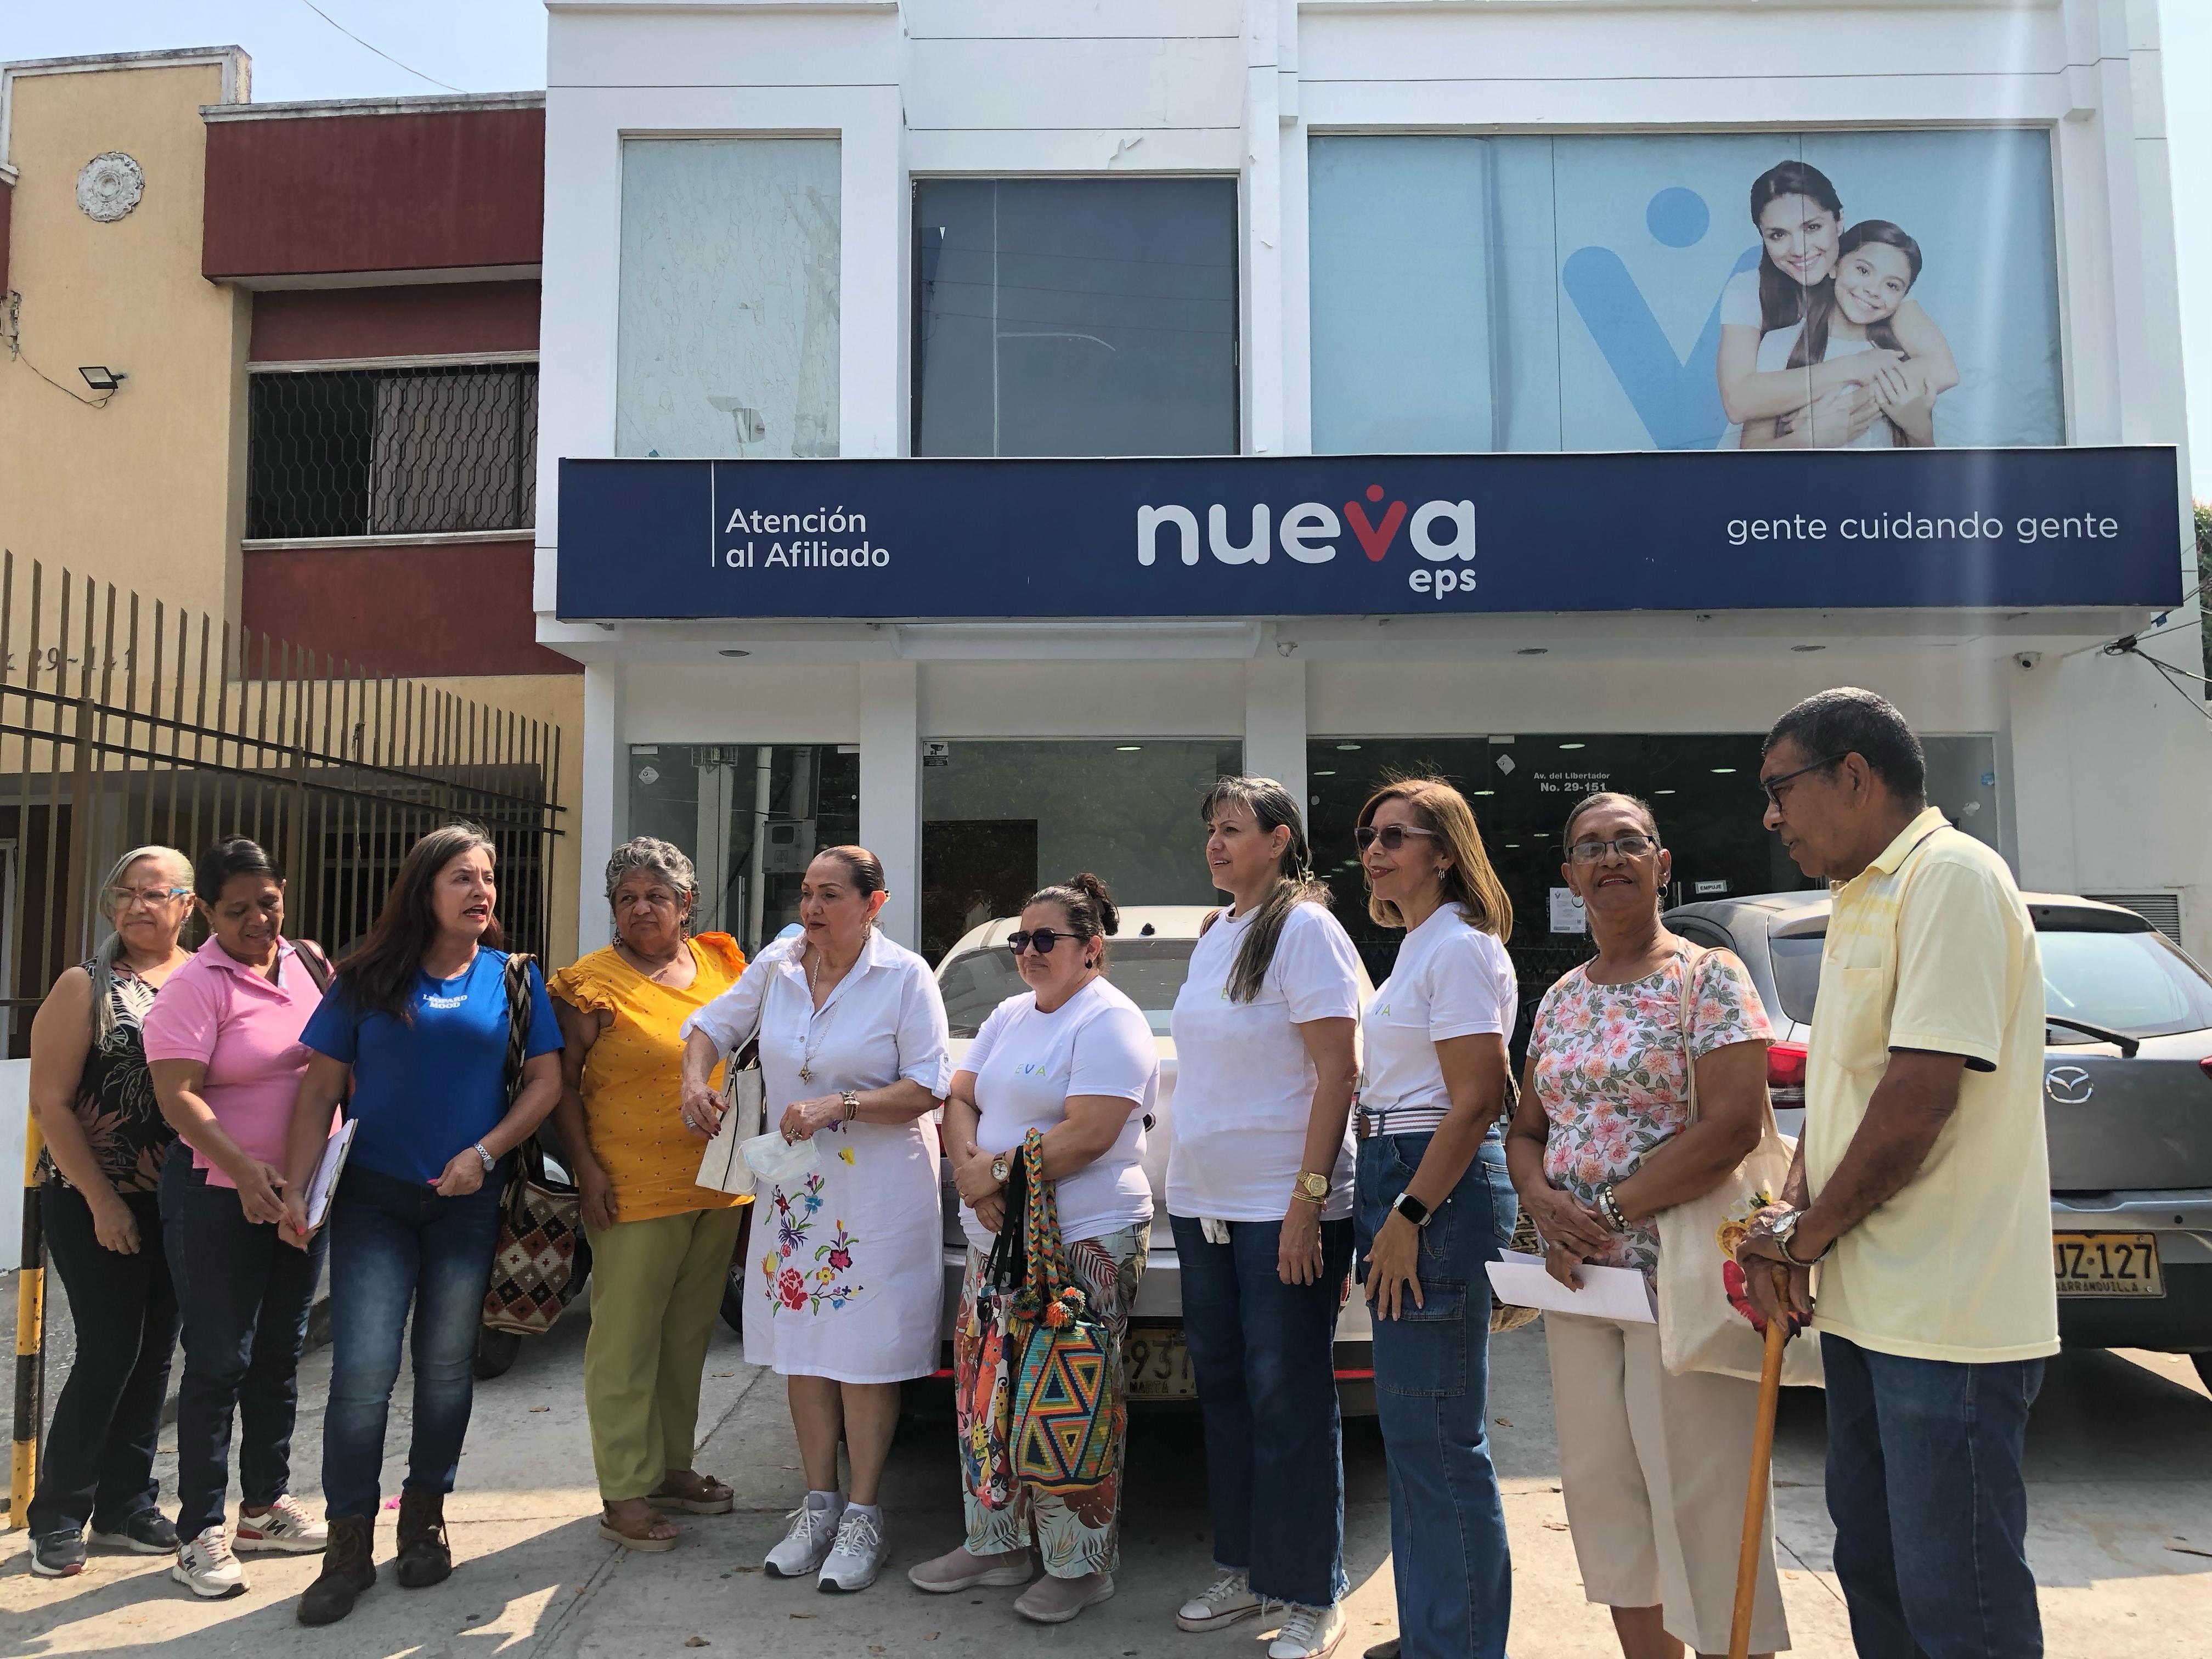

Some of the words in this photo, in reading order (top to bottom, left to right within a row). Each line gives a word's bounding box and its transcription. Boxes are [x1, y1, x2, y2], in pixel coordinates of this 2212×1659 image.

[725, 505, 866, 533] Atención
[1137, 485, 1476, 566] nueva
[1727, 514, 1827, 545] gente
[1840, 511, 2003, 539] cuidando
[2017, 513, 2118, 544] gente
[726, 541, 753, 568] al
[764, 541, 890, 567] Afiliado
[1409, 569, 1476, 600] eps
[1540, 782, 1560, 792] No.
[1564, 782, 1606, 792] 29-151
[1014, 1063, 1046, 1076] EVA
